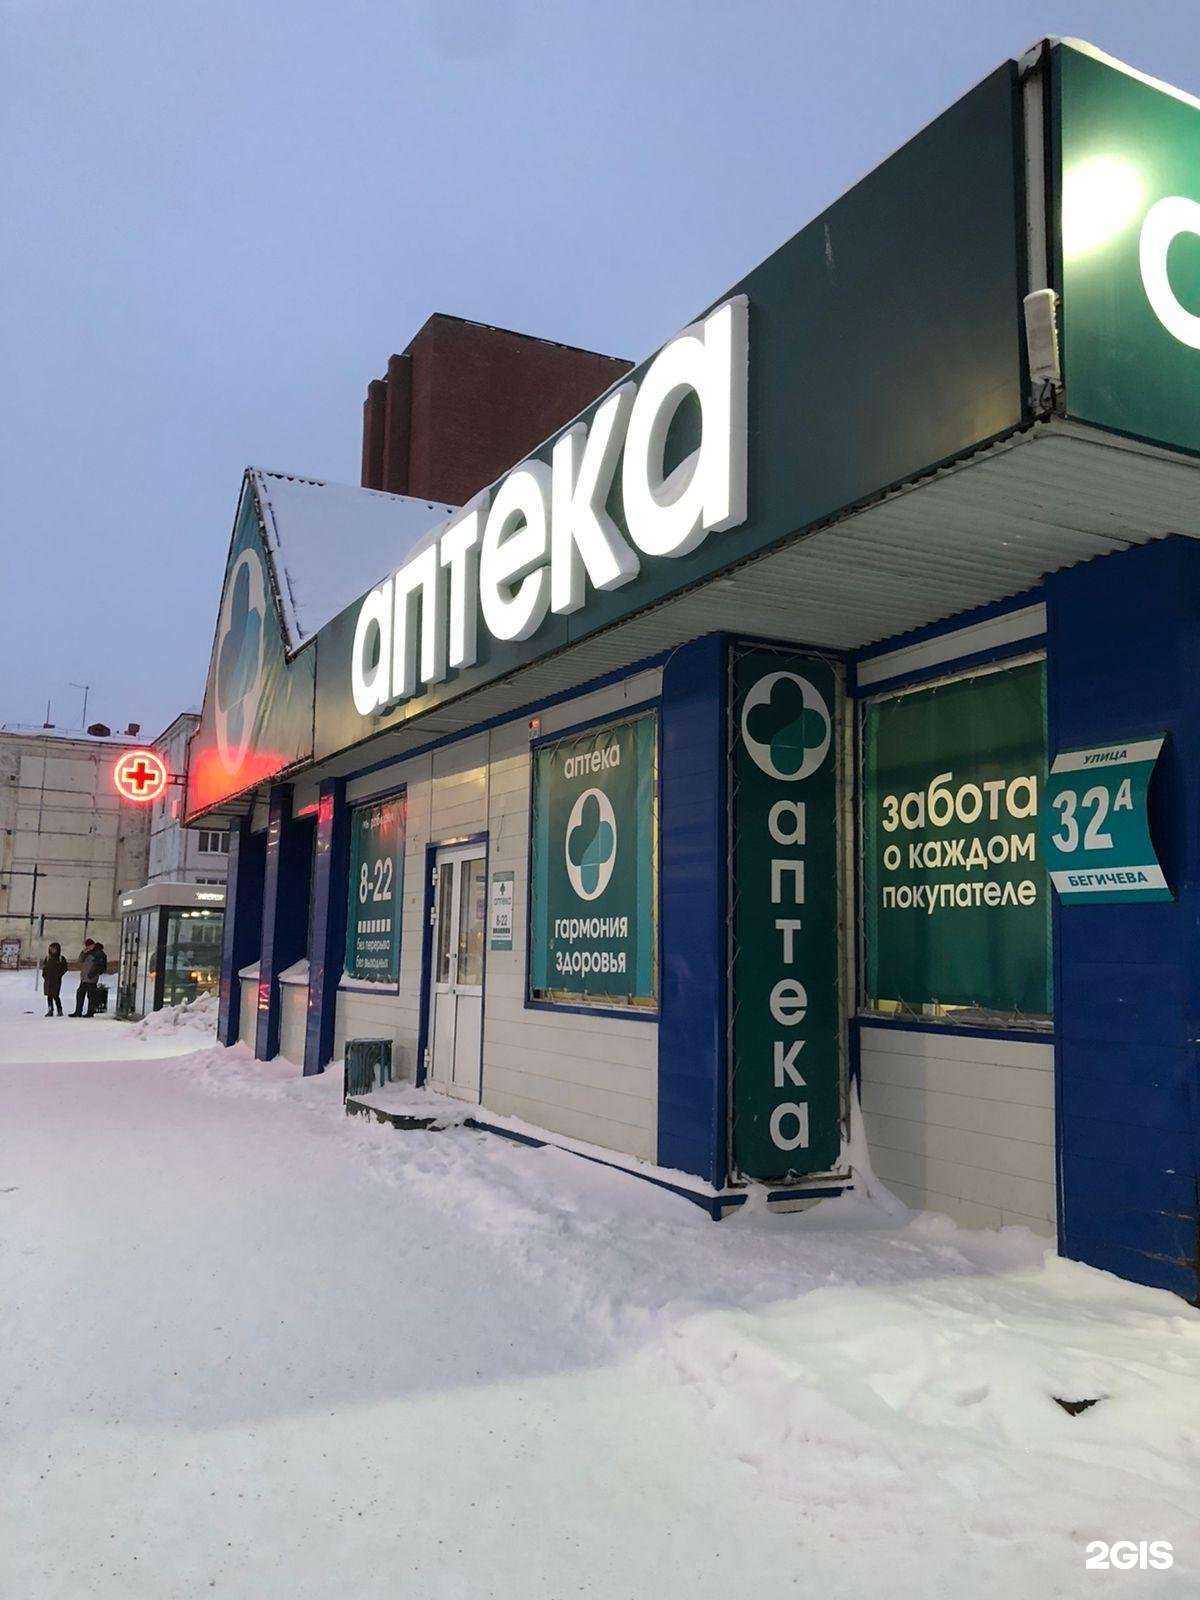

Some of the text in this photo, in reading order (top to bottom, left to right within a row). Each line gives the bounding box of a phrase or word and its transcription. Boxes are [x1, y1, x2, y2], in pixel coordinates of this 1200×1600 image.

[352, 296, 749, 716] аптека
[564, 744, 620, 779] аптека
[1083, 750, 1128, 765] УЛИЦА
[882, 772, 1038, 832] забота
[883, 833, 1036, 871] о каждом
[360, 857, 393, 904] 8-22
[1067, 871, 1148, 887] БЕГИЧЕВА
[882, 880, 1037, 915] покупателе
[555, 916, 628, 944] гармония
[556, 951, 626, 978] здоровья
[768, 800, 810, 1151] аптека
